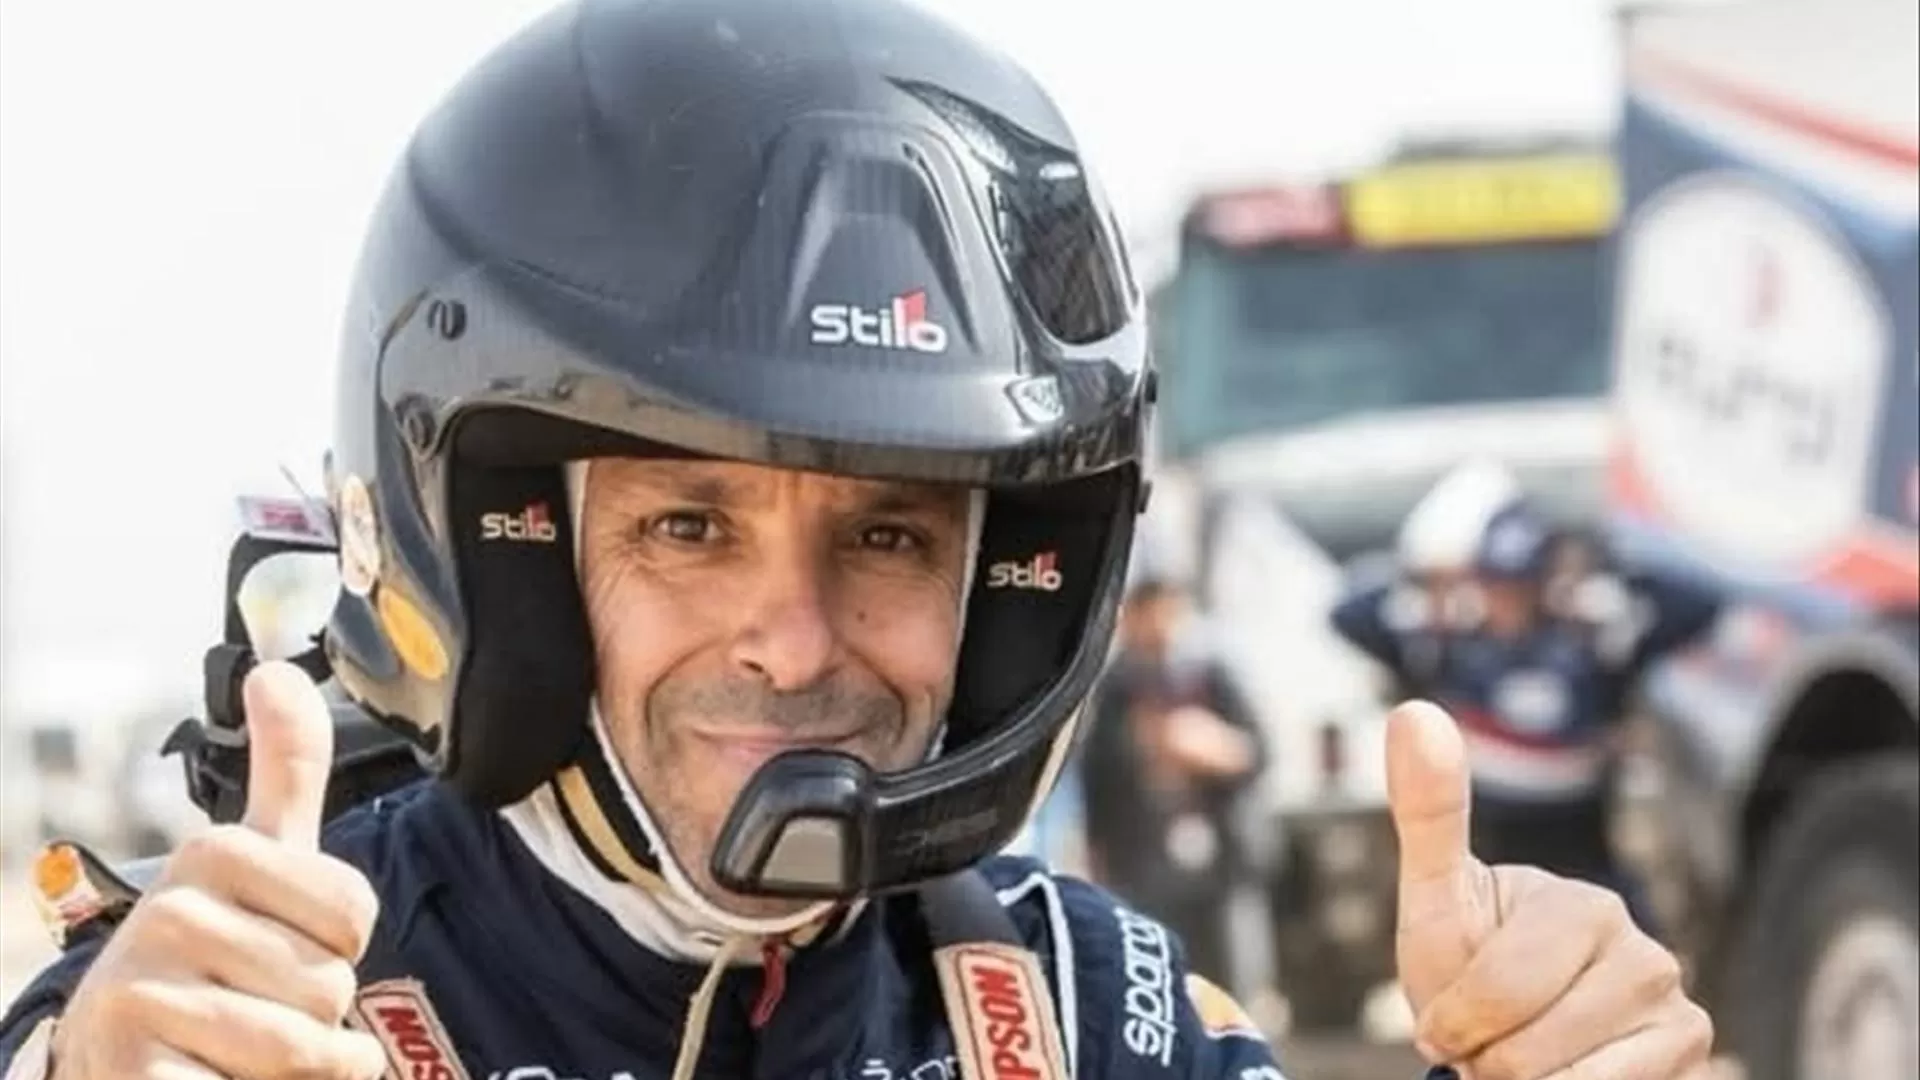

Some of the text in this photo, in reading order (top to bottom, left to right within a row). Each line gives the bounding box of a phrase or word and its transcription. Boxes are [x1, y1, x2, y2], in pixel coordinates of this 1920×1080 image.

[811, 291, 946, 352] Stilo
[481, 502, 557, 542] Stilo
[987, 553, 1063, 590] Stilo
